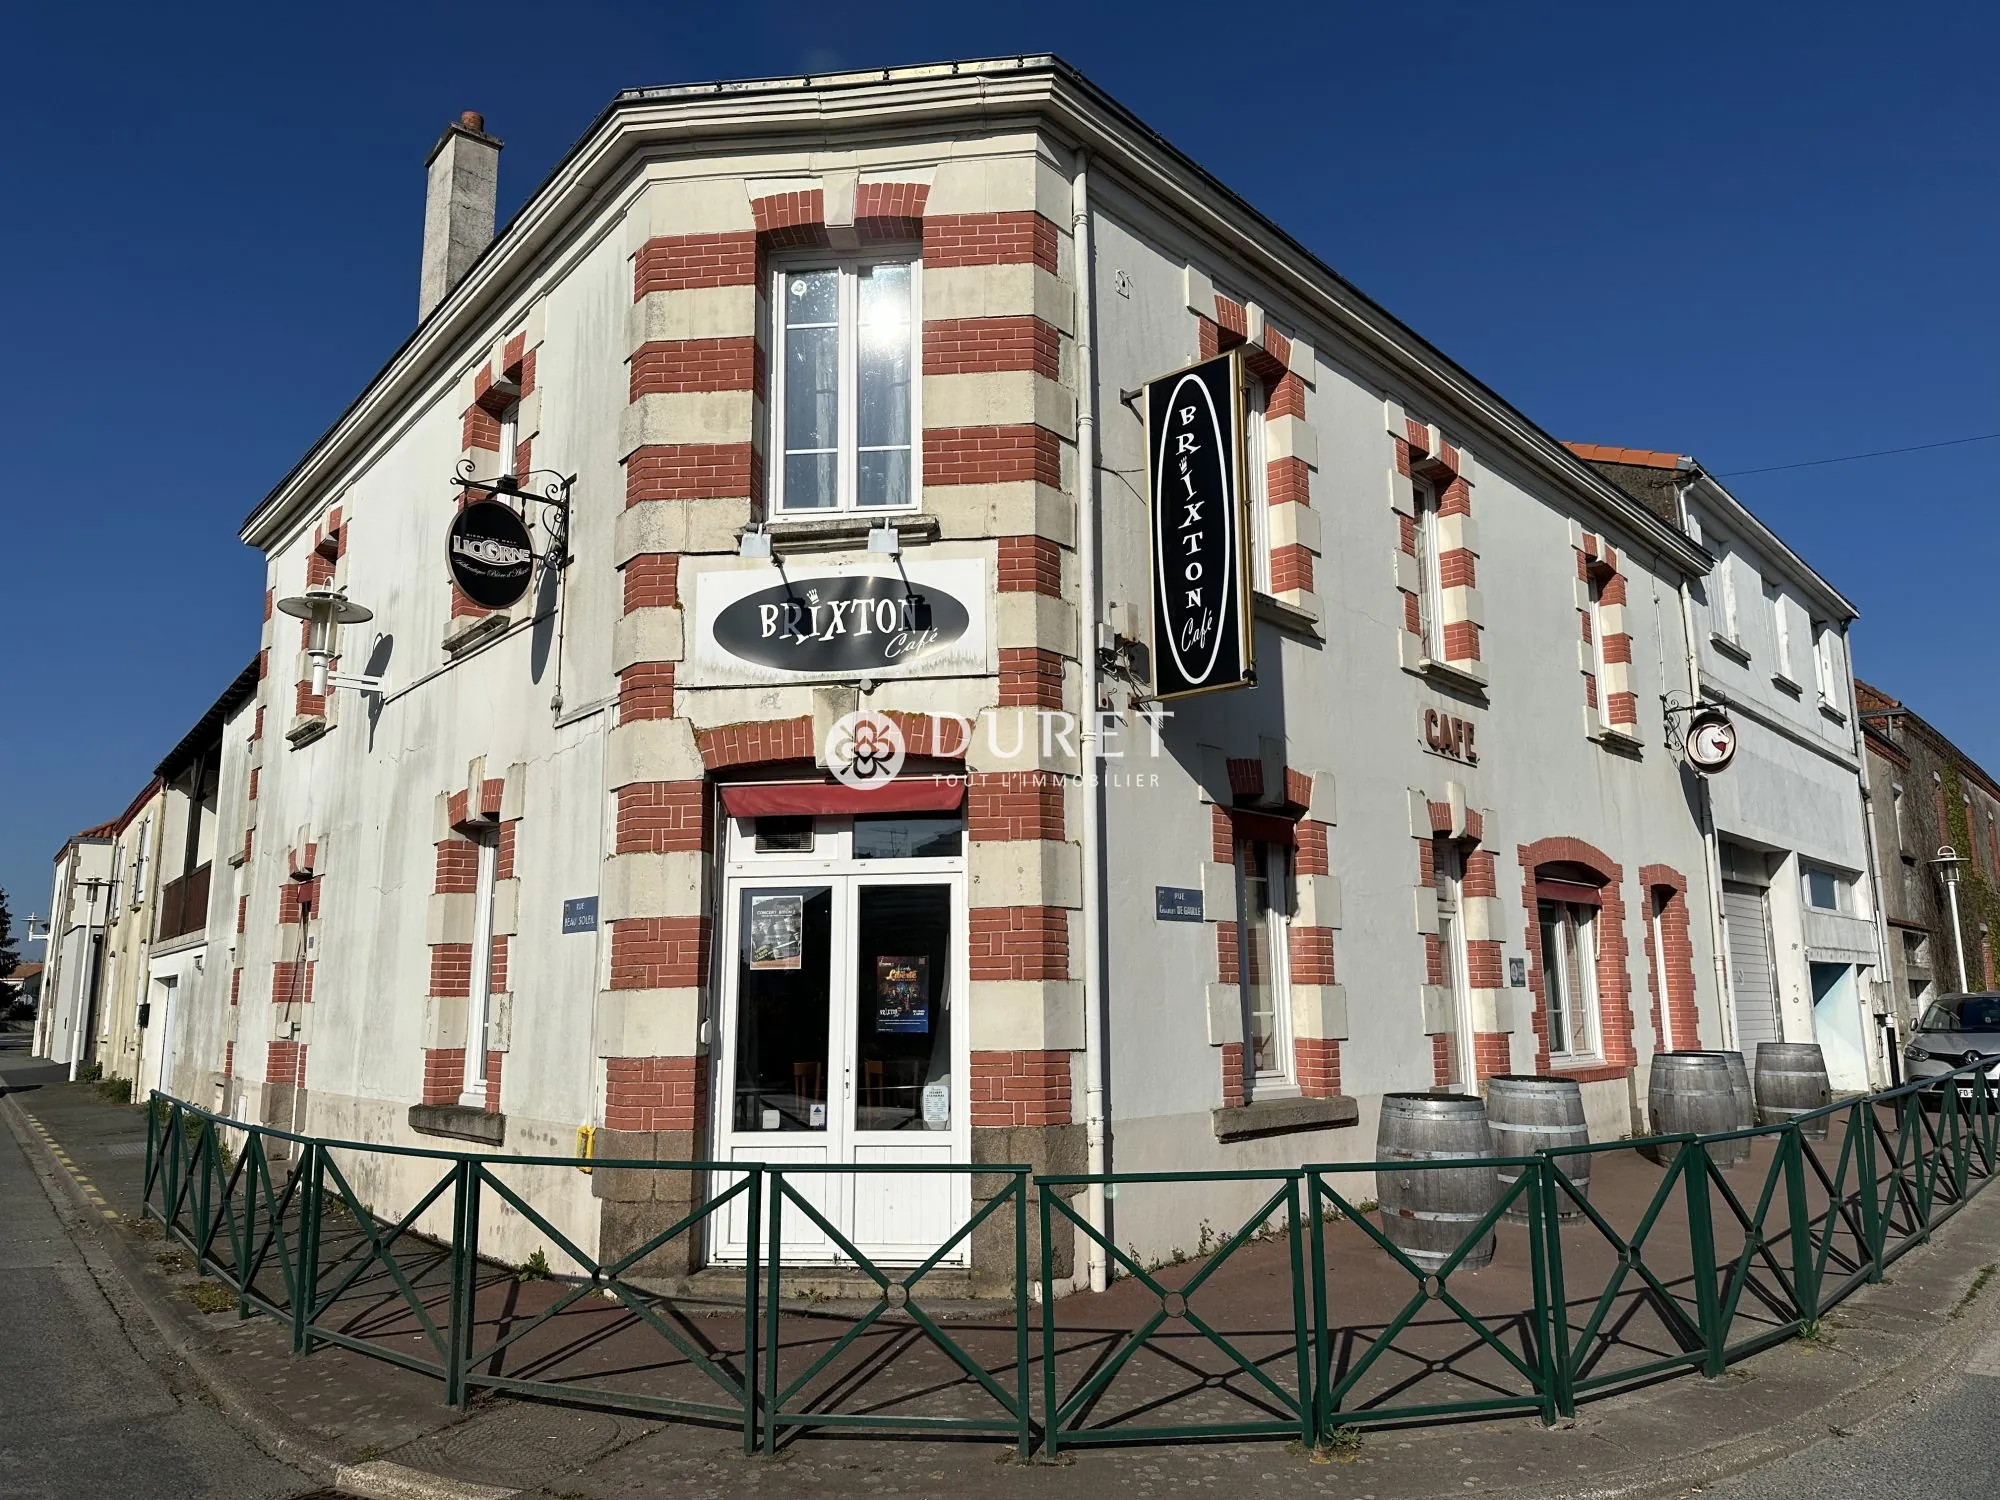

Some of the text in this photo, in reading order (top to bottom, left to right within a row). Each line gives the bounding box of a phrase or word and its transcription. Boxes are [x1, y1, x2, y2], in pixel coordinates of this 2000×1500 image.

[1175, 405, 1206, 609] BRIXTON
[453, 535, 530, 562] LICORNE
[758, 597, 917, 646] BRIXTON
[884, 627, 939, 659] Café
[1181, 607, 1213, 652] Café
[1425, 709, 1477, 763] CAFE
